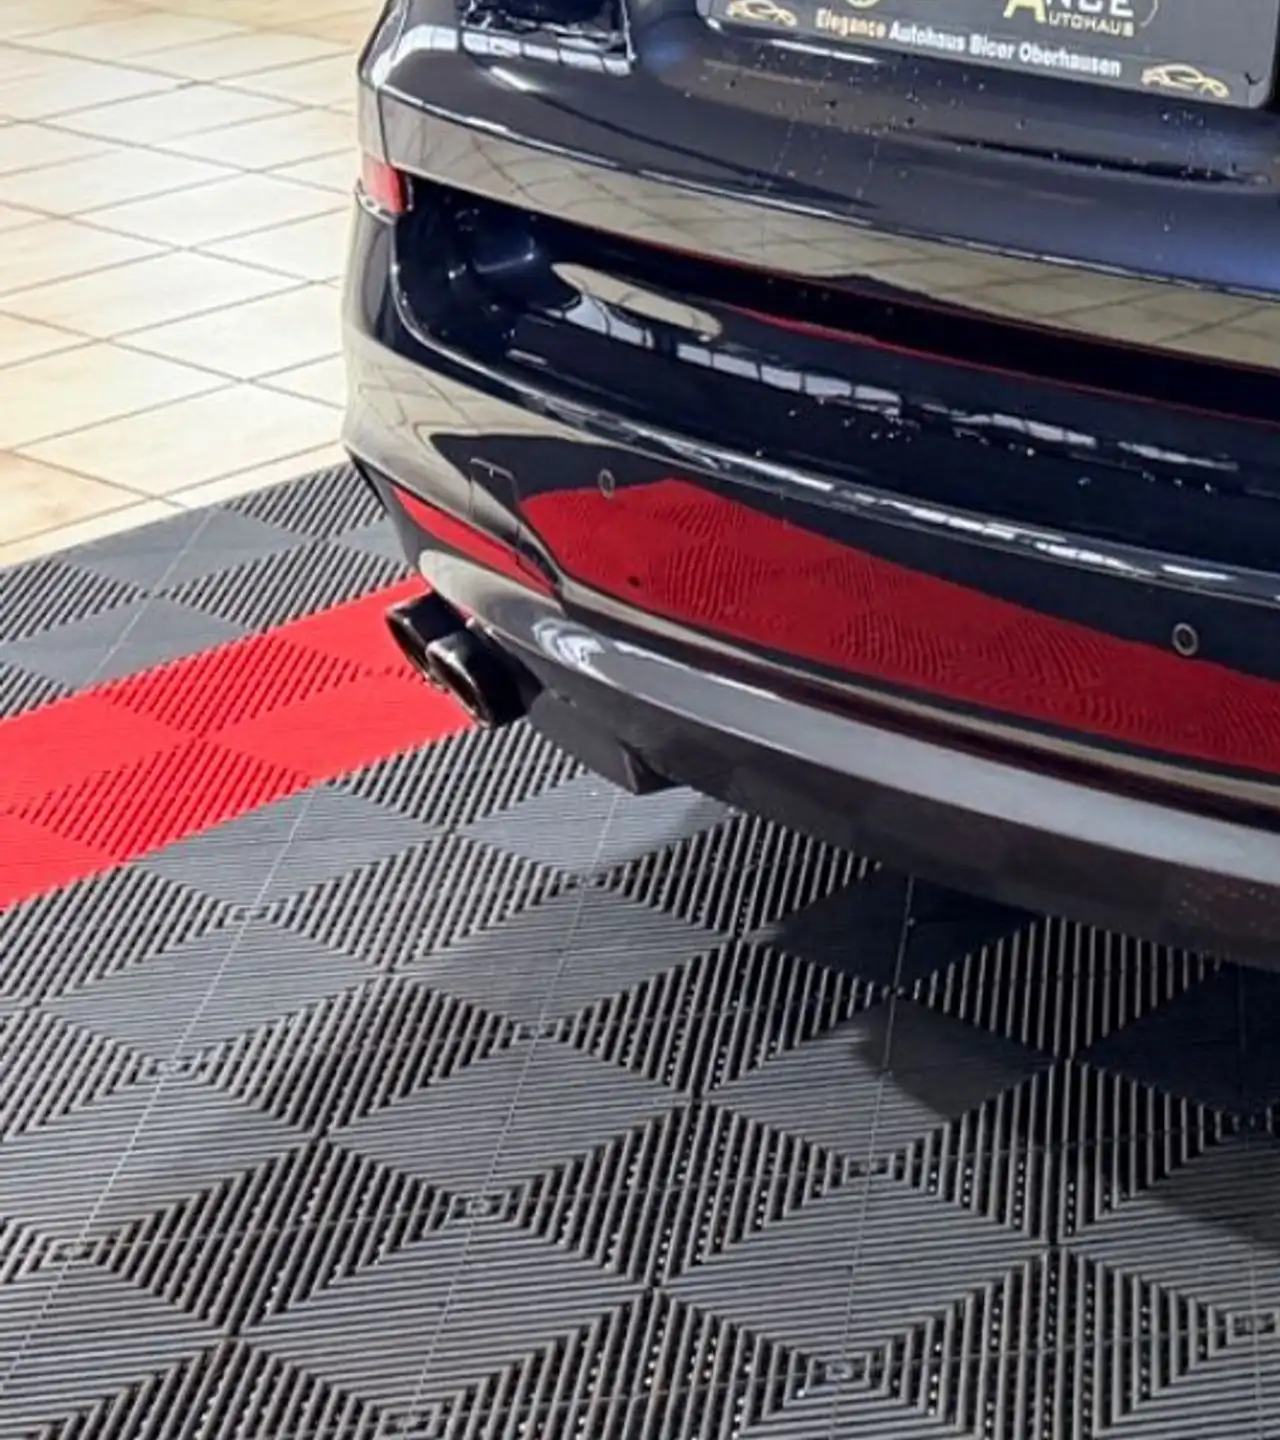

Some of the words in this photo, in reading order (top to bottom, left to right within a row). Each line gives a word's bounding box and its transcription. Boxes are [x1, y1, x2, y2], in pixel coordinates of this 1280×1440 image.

[815, 8, 886, 38] Elegance
[888, 20, 965, 53] Autohaus
[1018, 42, 1122, 78] Oberhausen
